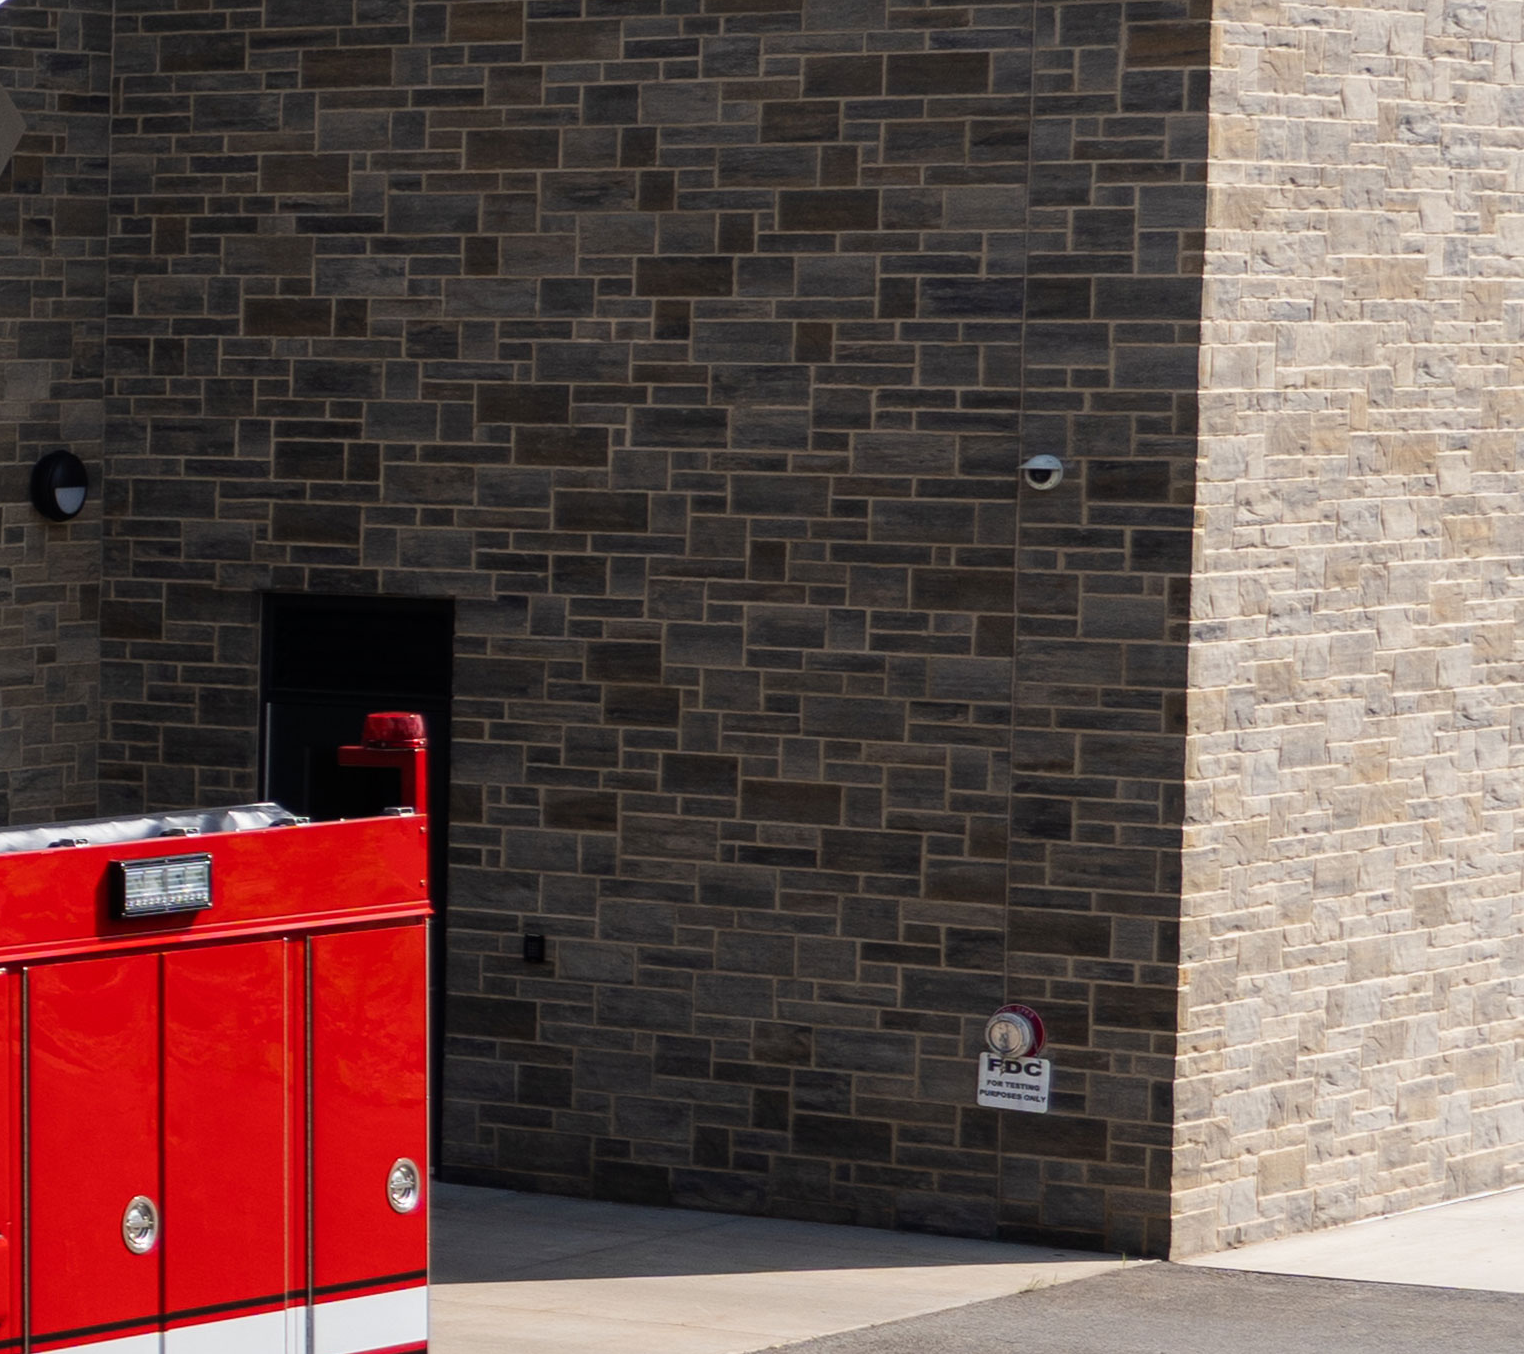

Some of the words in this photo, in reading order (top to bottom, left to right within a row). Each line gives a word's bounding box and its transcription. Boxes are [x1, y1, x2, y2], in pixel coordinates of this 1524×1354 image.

[987, 1058, 1042, 1077] FDC
[986, 1079, 1004, 1087] FOR
[1005, 1081, 1040, 1092] TESTING
[979, 1088, 1023, 1101] PURPOSES
[1023, 1094, 1046, 1103] ONLY
